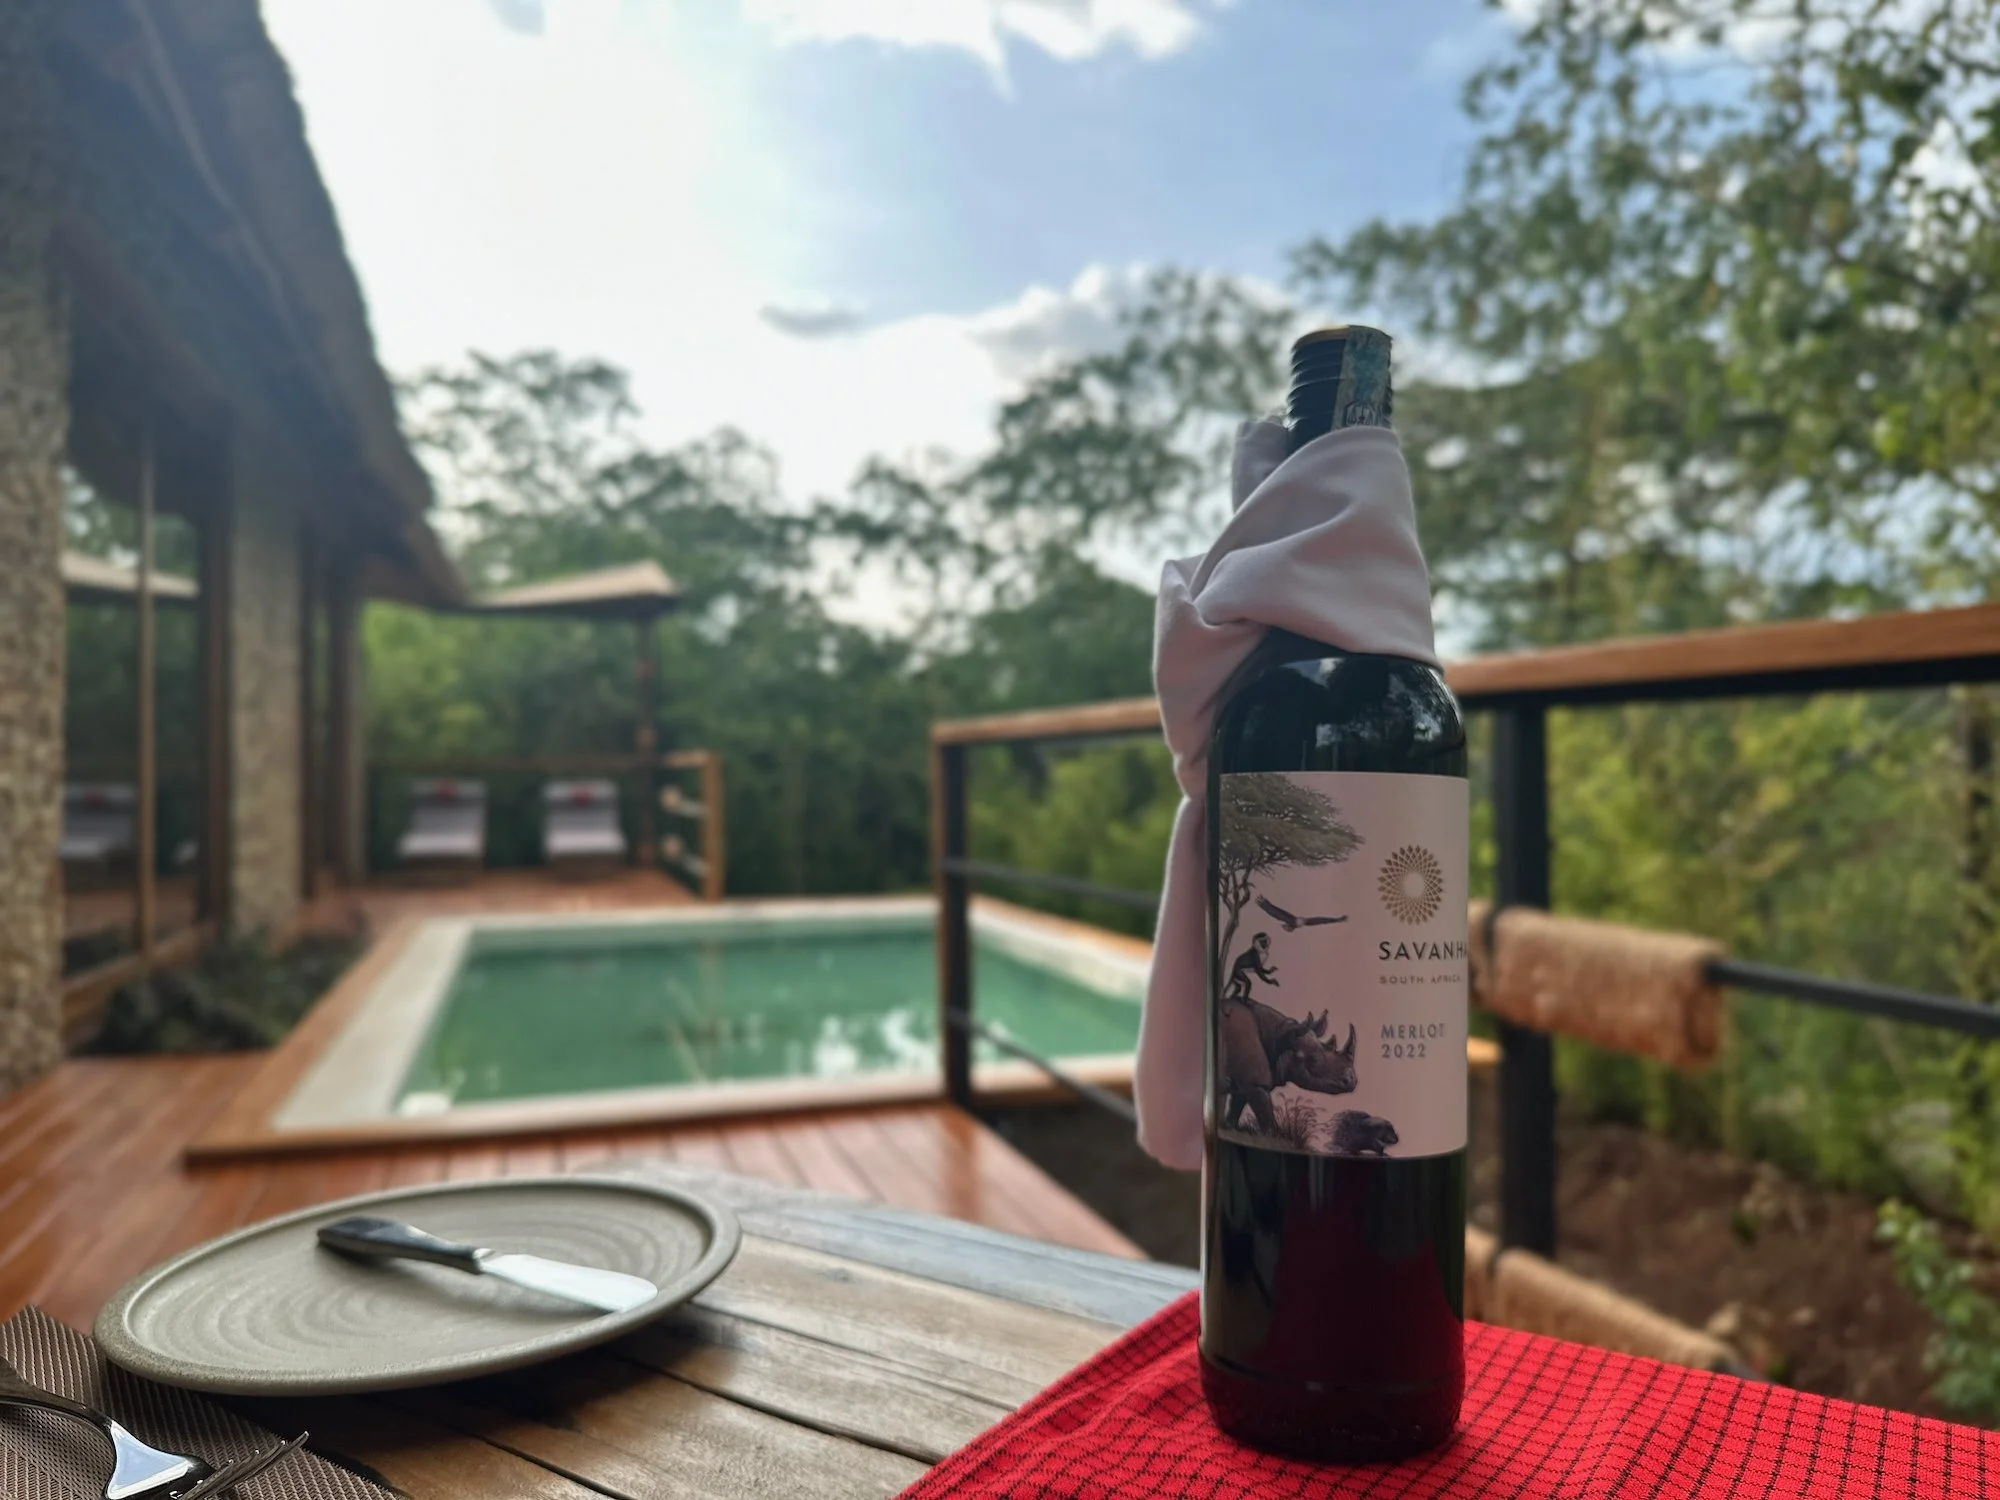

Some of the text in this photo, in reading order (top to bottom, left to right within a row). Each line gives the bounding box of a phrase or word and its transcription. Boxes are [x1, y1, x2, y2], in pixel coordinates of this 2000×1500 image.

[1379, 975, 1425, 985] SOUTH
[1380, 1023, 1446, 1040] MERLOT
[1381, 1042, 1427, 1059] 2022
